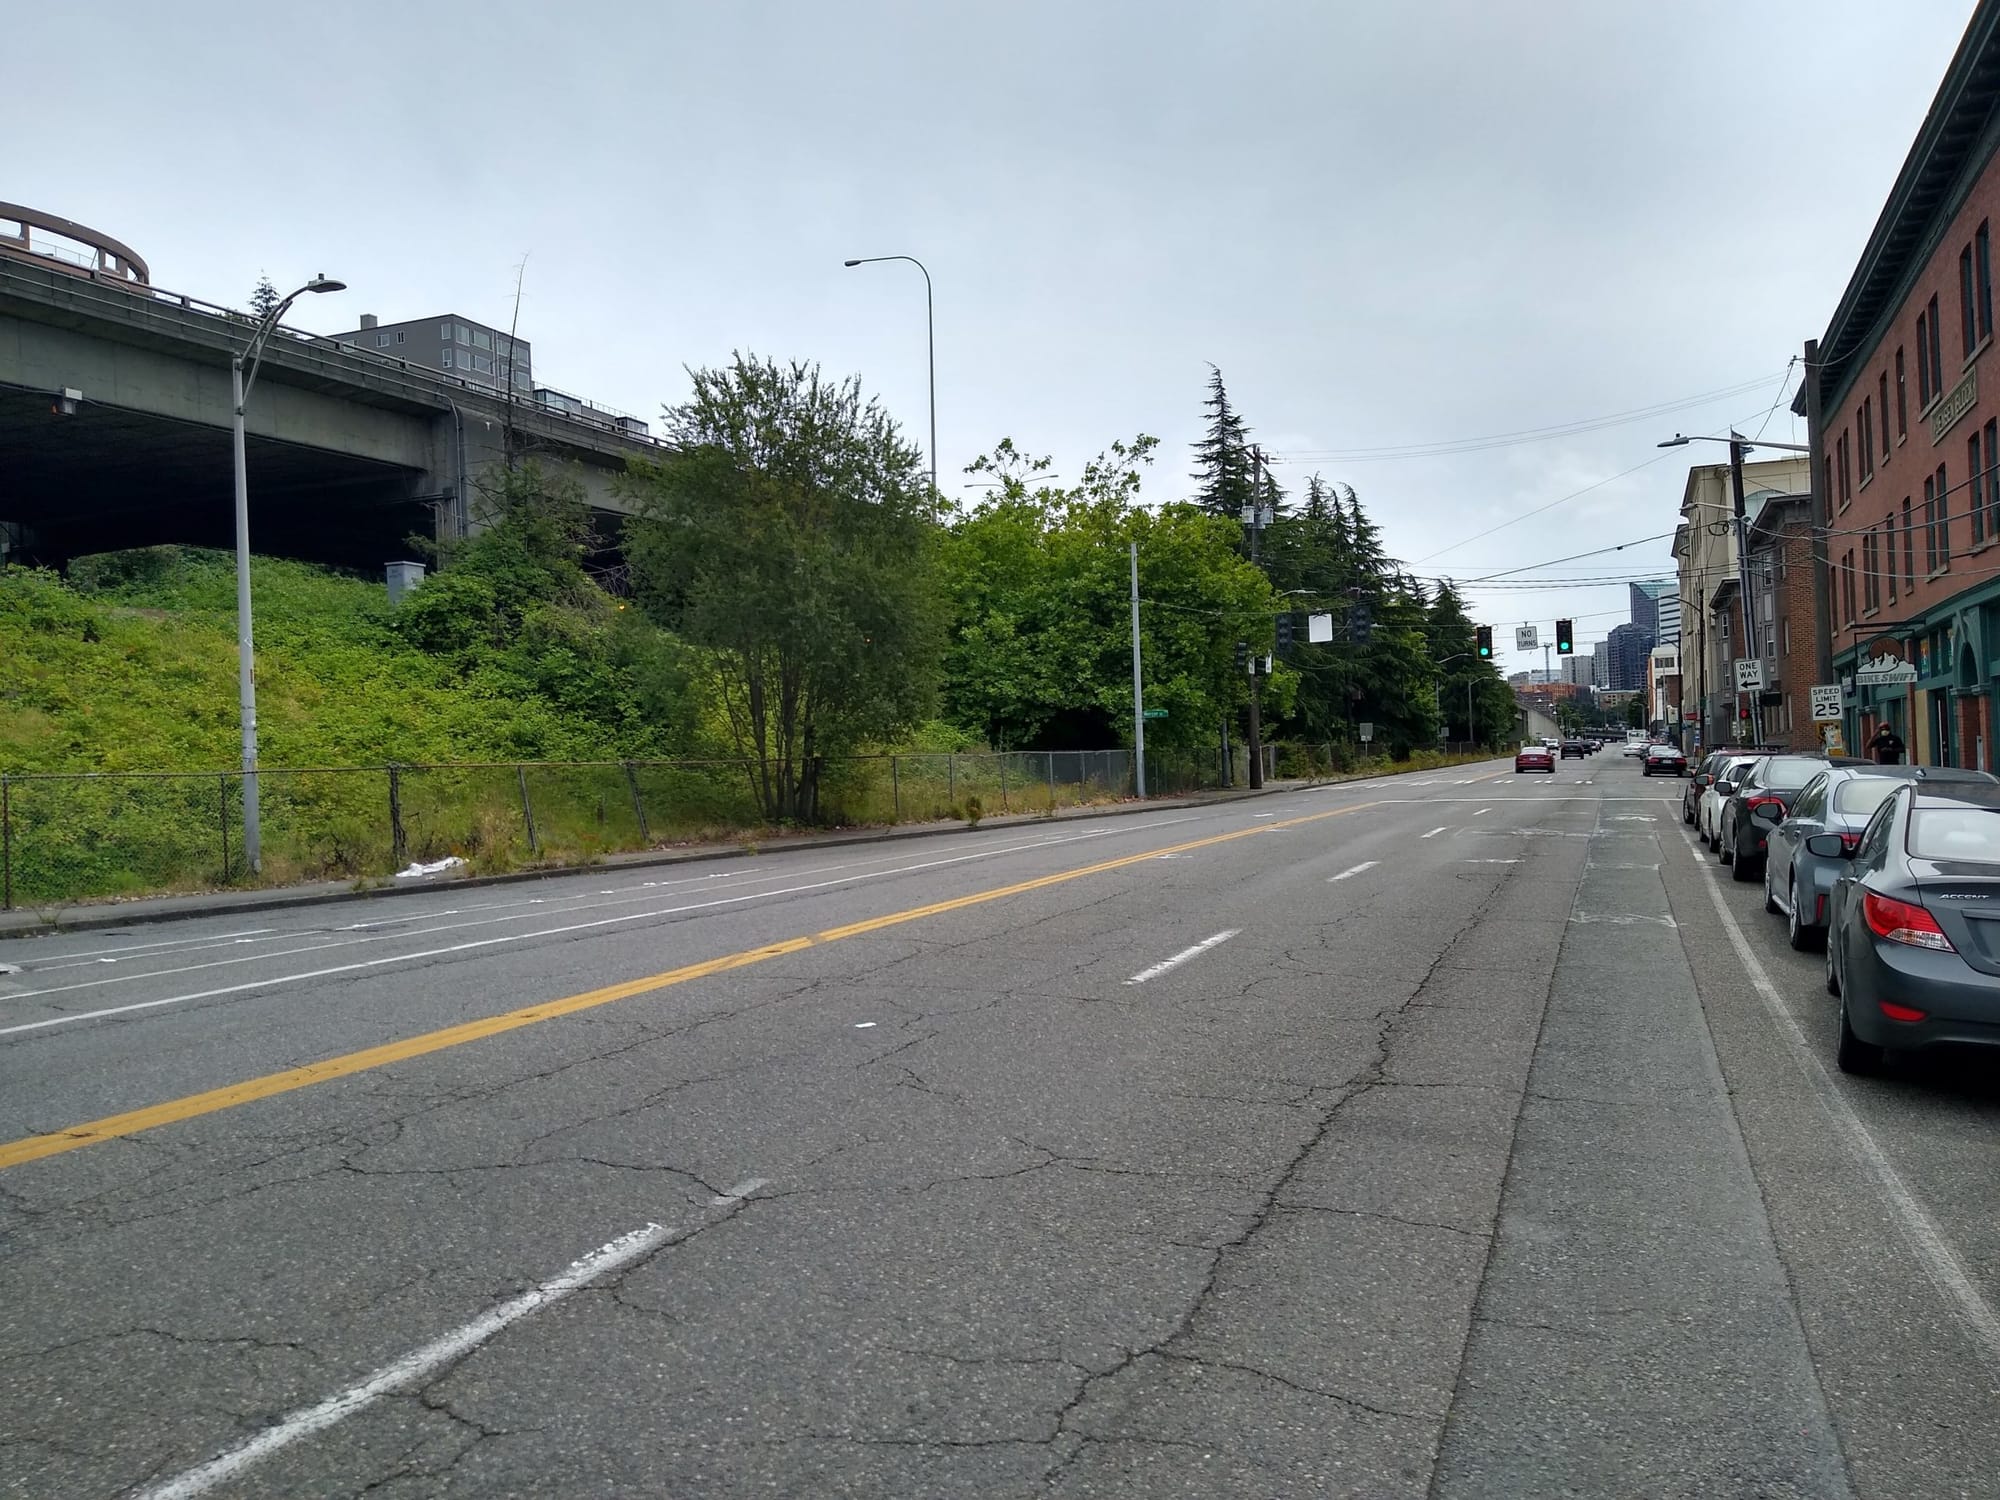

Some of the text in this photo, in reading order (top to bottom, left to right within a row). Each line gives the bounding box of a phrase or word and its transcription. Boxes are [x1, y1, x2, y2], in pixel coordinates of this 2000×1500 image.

[1521, 630, 1532, 638] NO
[1517, 640, 1537, 648] TURNS
[1740, 662, 1757, 671] ONE
[1740, 670, 1758, 679] WAY
[1813, 688, 1840, 696] SPEED
[1815, 695, 1836, 703] LIMIT
[1815, 702, 1840, 717] 25
